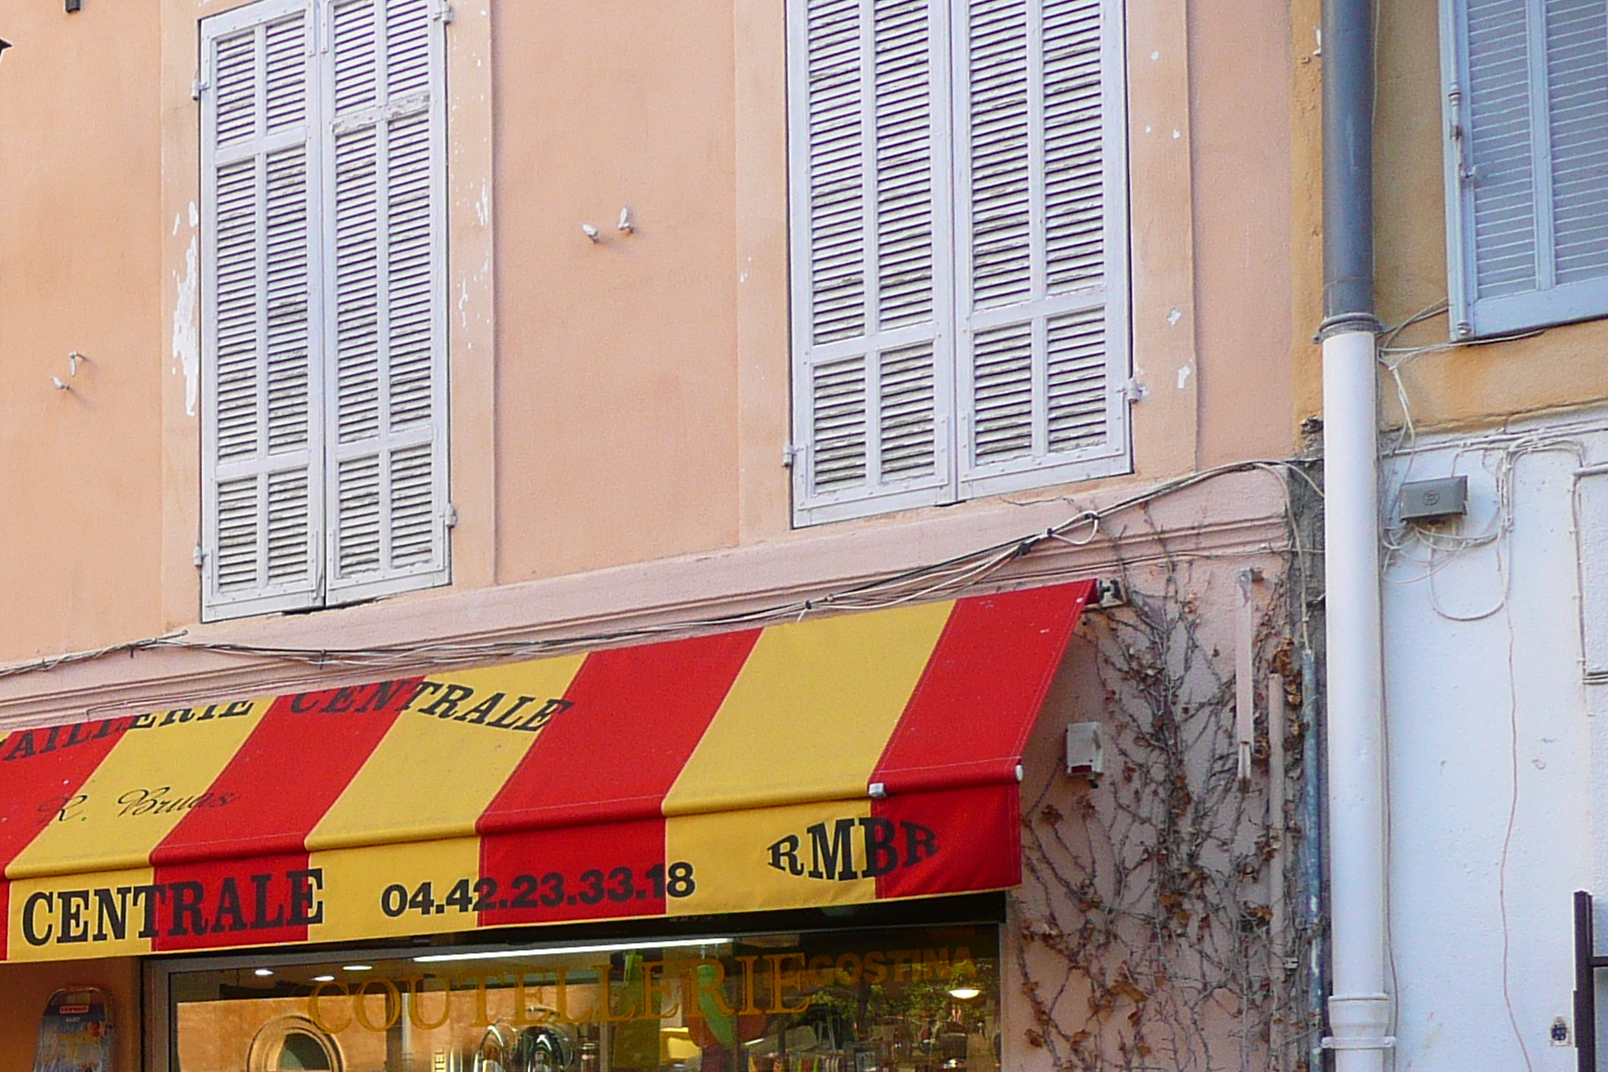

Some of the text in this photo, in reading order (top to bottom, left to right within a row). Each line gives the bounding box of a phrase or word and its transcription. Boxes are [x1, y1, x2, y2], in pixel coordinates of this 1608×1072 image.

[289, 679, 574, 734] CENTRALE
[768, 815, 941, 883] RMBR
[21, 867, 324, 947] CENTRALE
[381, 861, 696, 918] 04.42.23.33.18
[307, 952, 814, 1035] COUTELLERIE
